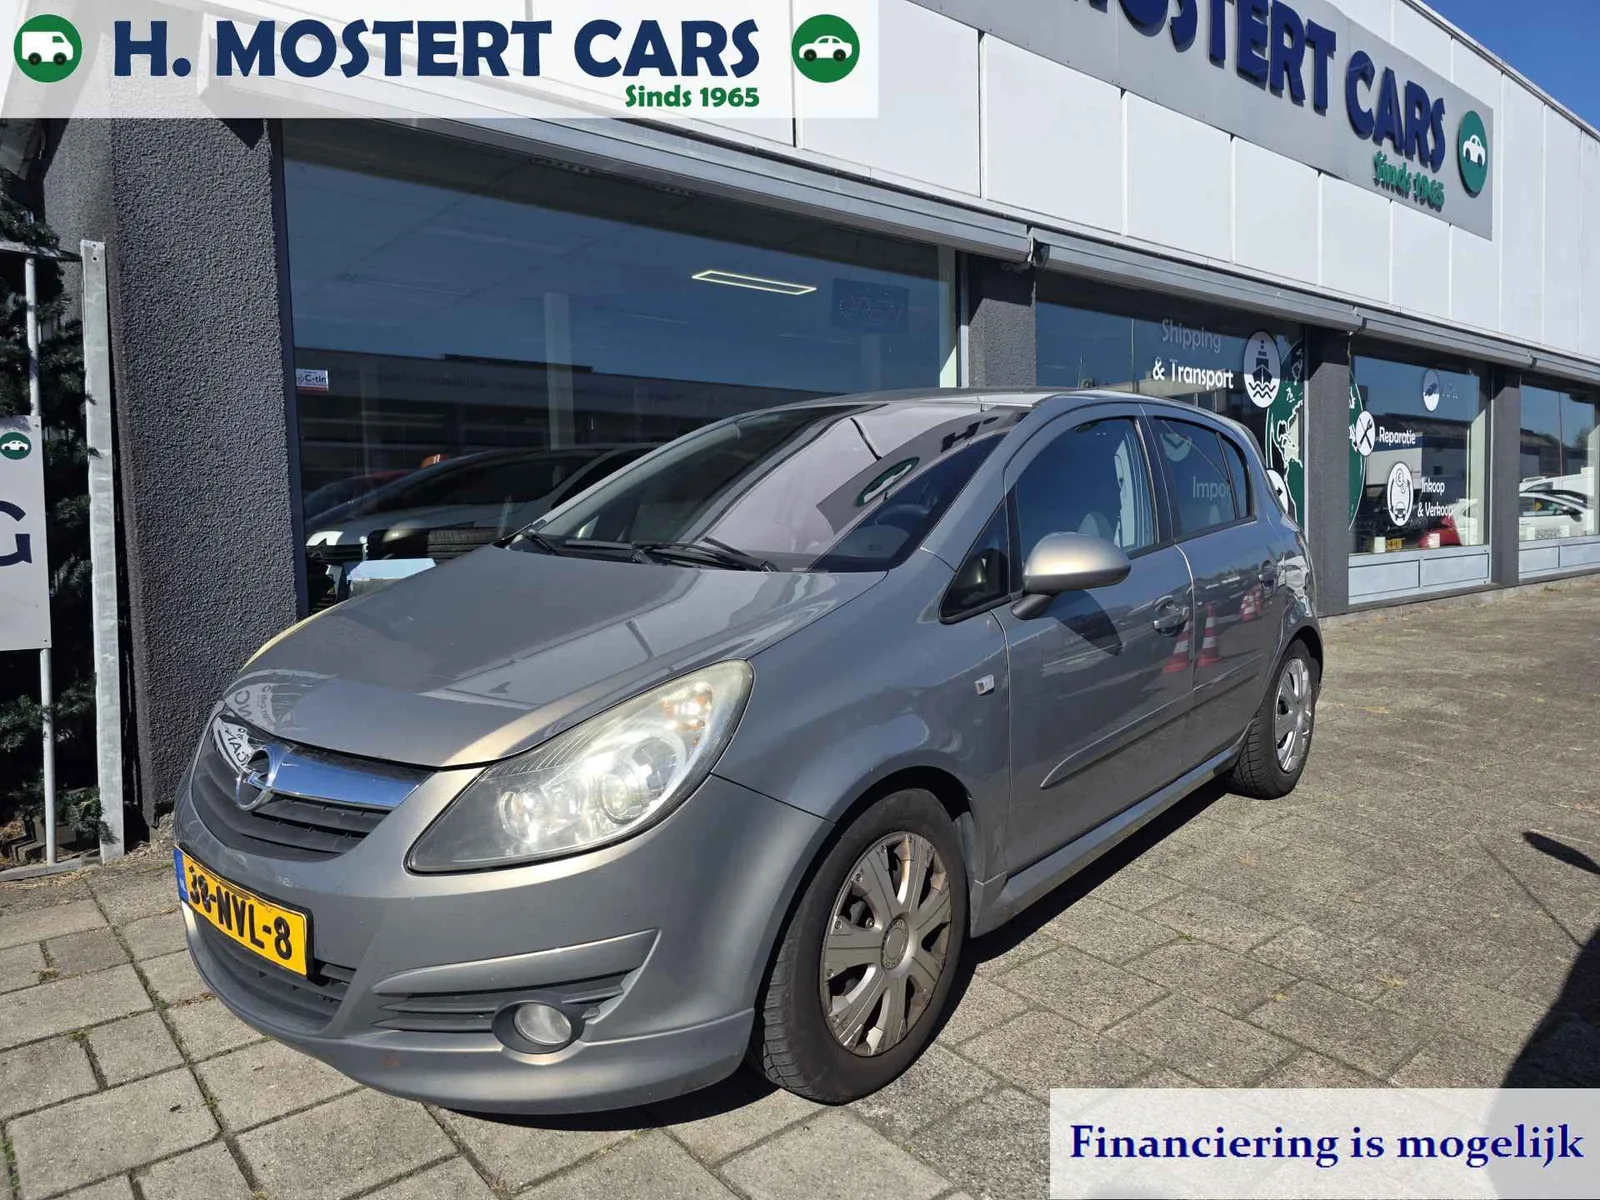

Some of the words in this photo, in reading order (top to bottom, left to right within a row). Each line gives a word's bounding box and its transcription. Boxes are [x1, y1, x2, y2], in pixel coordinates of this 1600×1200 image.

[1073, 0, 1336, 116] TERT
[1345, 50, 1446, 173] CARS
[1373, 151, 1412, 199] Sinds
[1413, 172, 1445, 212] 1965
[1161, 318, 1222, 354] Shipping
[1152, 356, 1166, 381] &
[1168, 358, 1234, 391] Transport
[1379, 426, 1416, 447] Reparatie
[1421, 476, 1446, 496] Inkoop
[1417, 501, 1425, 517] &
[1424, 501, 1454, 519] Verkoop
[188, 865, 292, 960] 38-NVL-8
